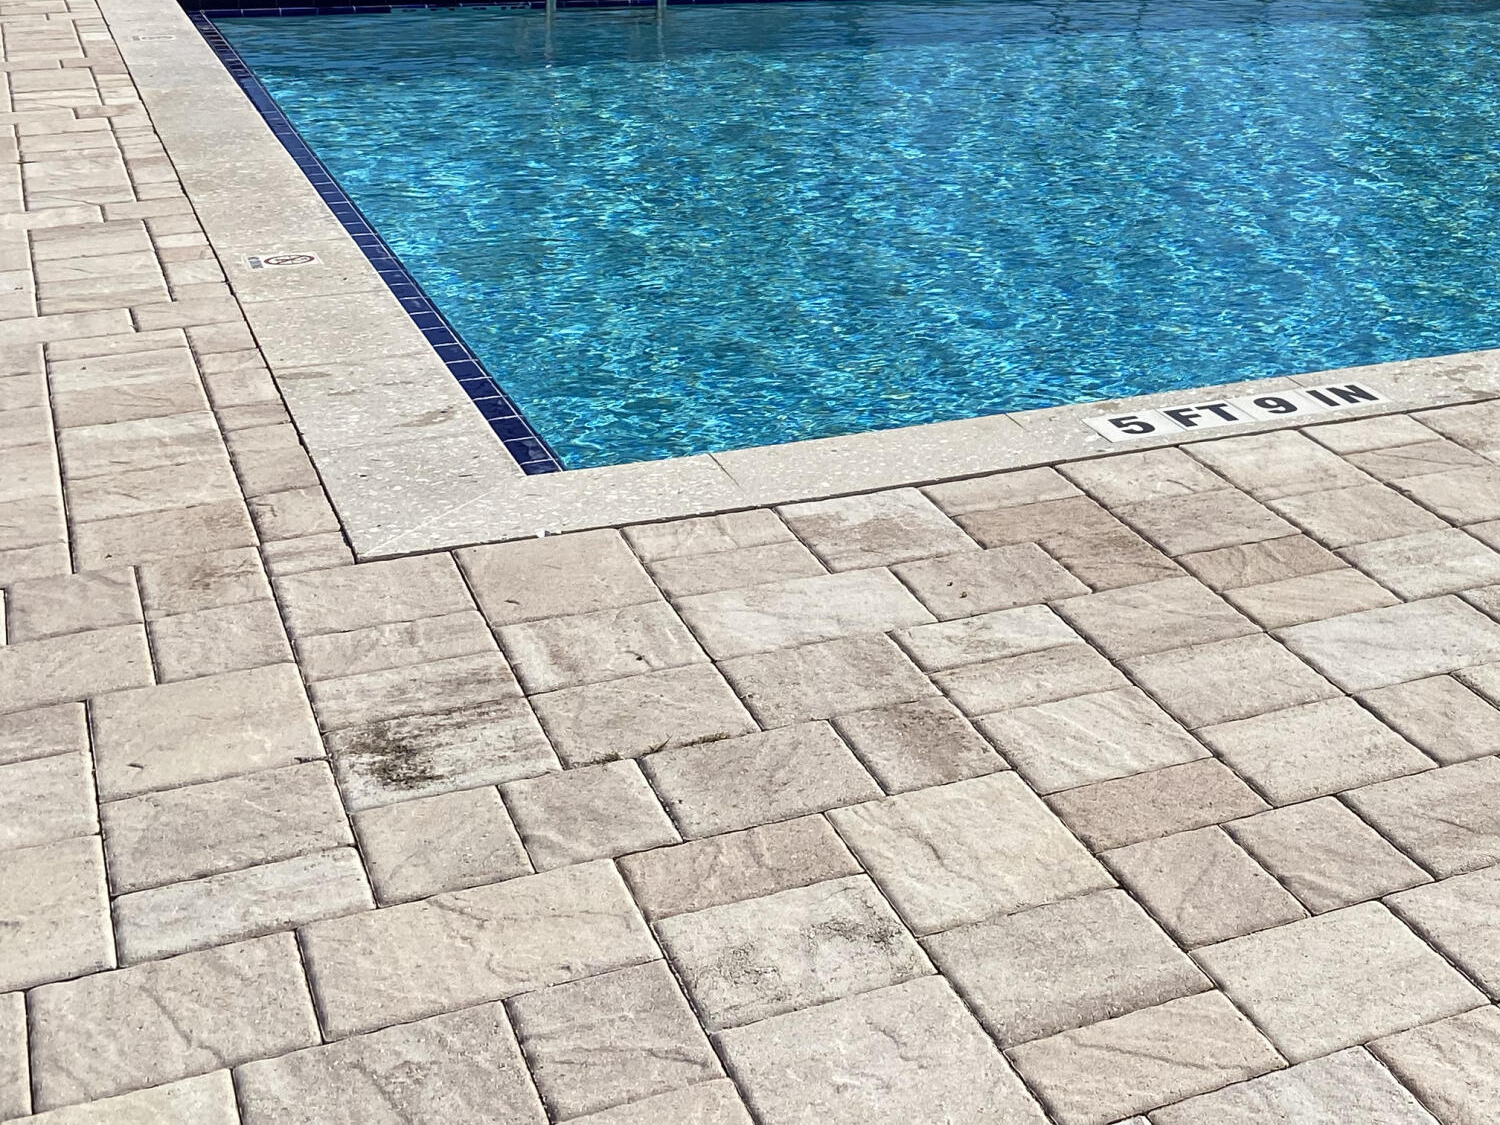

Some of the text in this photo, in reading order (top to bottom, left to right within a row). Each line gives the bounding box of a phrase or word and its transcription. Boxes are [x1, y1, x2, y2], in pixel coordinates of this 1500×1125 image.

[1108, 384, 1379, 434] 5 FT 9 IN
